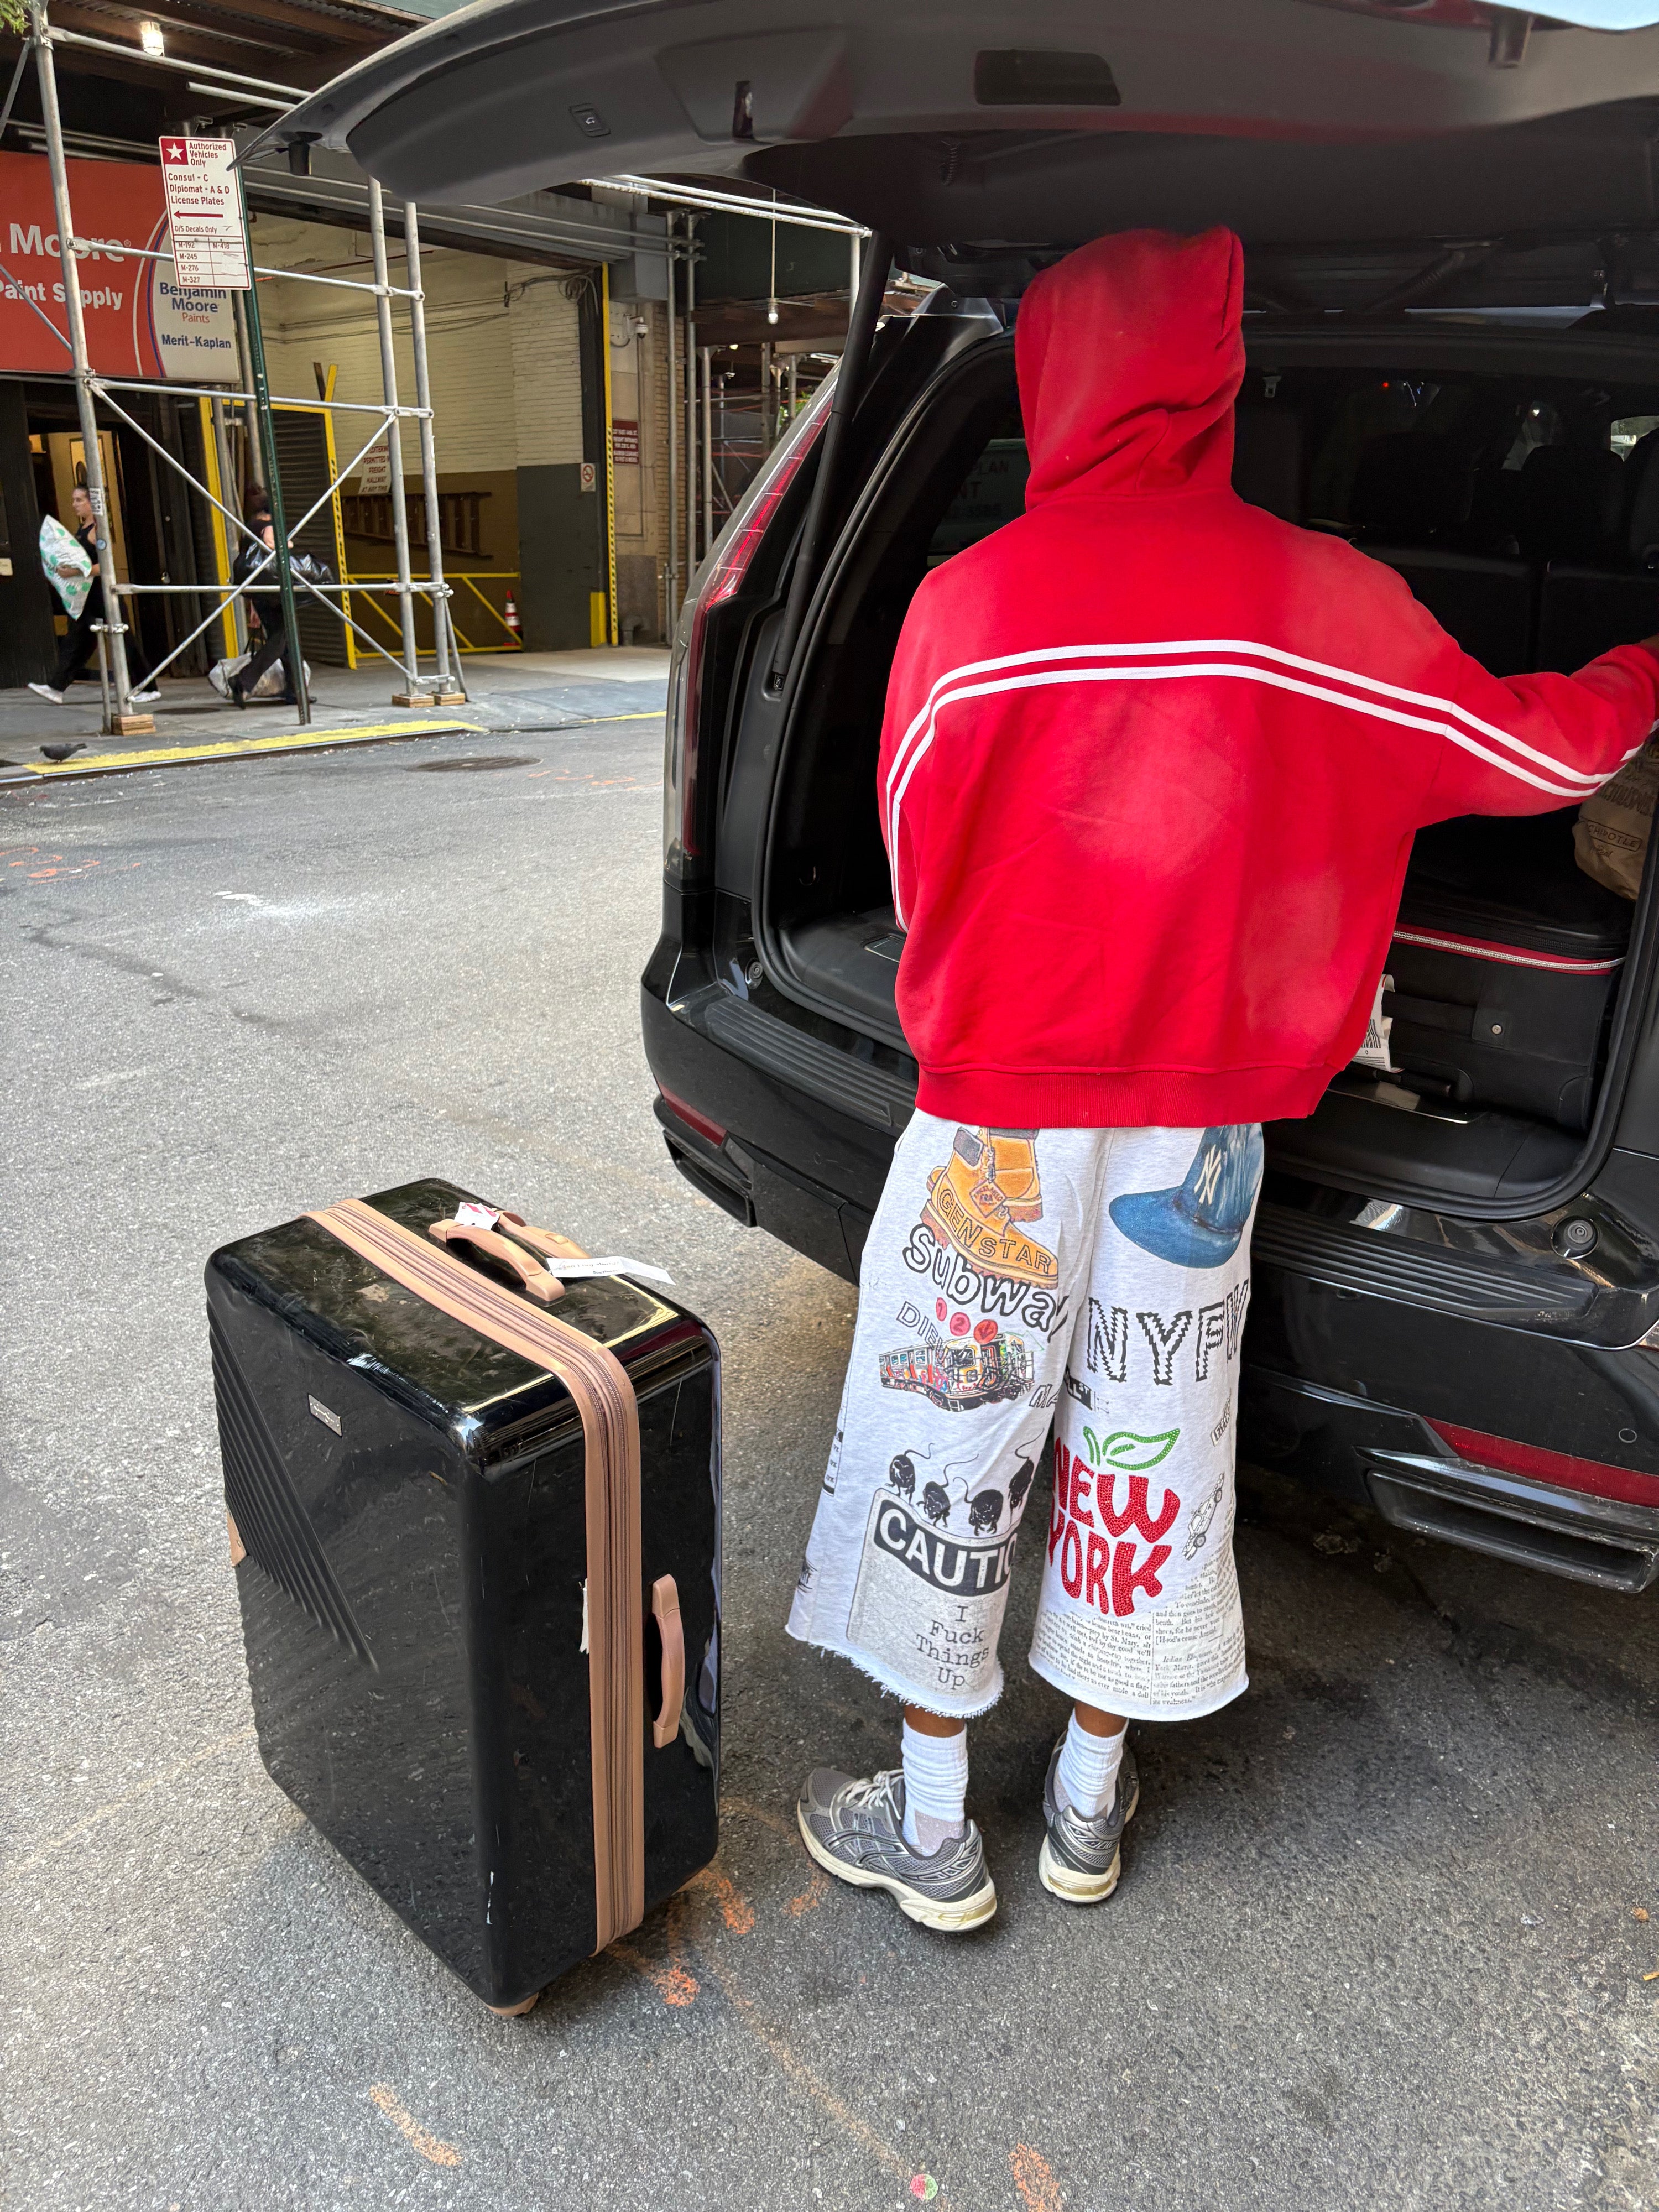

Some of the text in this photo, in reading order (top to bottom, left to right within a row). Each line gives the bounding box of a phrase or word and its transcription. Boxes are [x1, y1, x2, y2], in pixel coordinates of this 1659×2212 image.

[189, 142, 227, 151] Authorized
[190, 150, 218, 159] Vehicles
[191, 158, 206, 168] Only
[168, 173, 195, 182] Consul
[169, 184, 203, 194] Diplomat
[171, 196, 225, 205] License Plates
[53, 282, 123, 310] Spply
[160, 282, 227, 300] Benjamin
[172, 298, 218, 312] Moore
[182, 312, 210, 324] Paints
[161, 334, 231, 350] Merit-Kaplan
[939, 1189, 1052, 1275] GENSTAR
[902, 1223, 1070, 1343] Subway
[1051, 1437, 1181, 1545] NEW
[880, 1508, 1018, 1589] CAUTIO
[1048, 1493, 1173, 1618] YORK
[955, 1605, 968, 1622] I
[929, 1619, 985, 1645] Fuck
[916, 1634, 990, 1670] Things
[937, 1666, 966, 1691] Up
